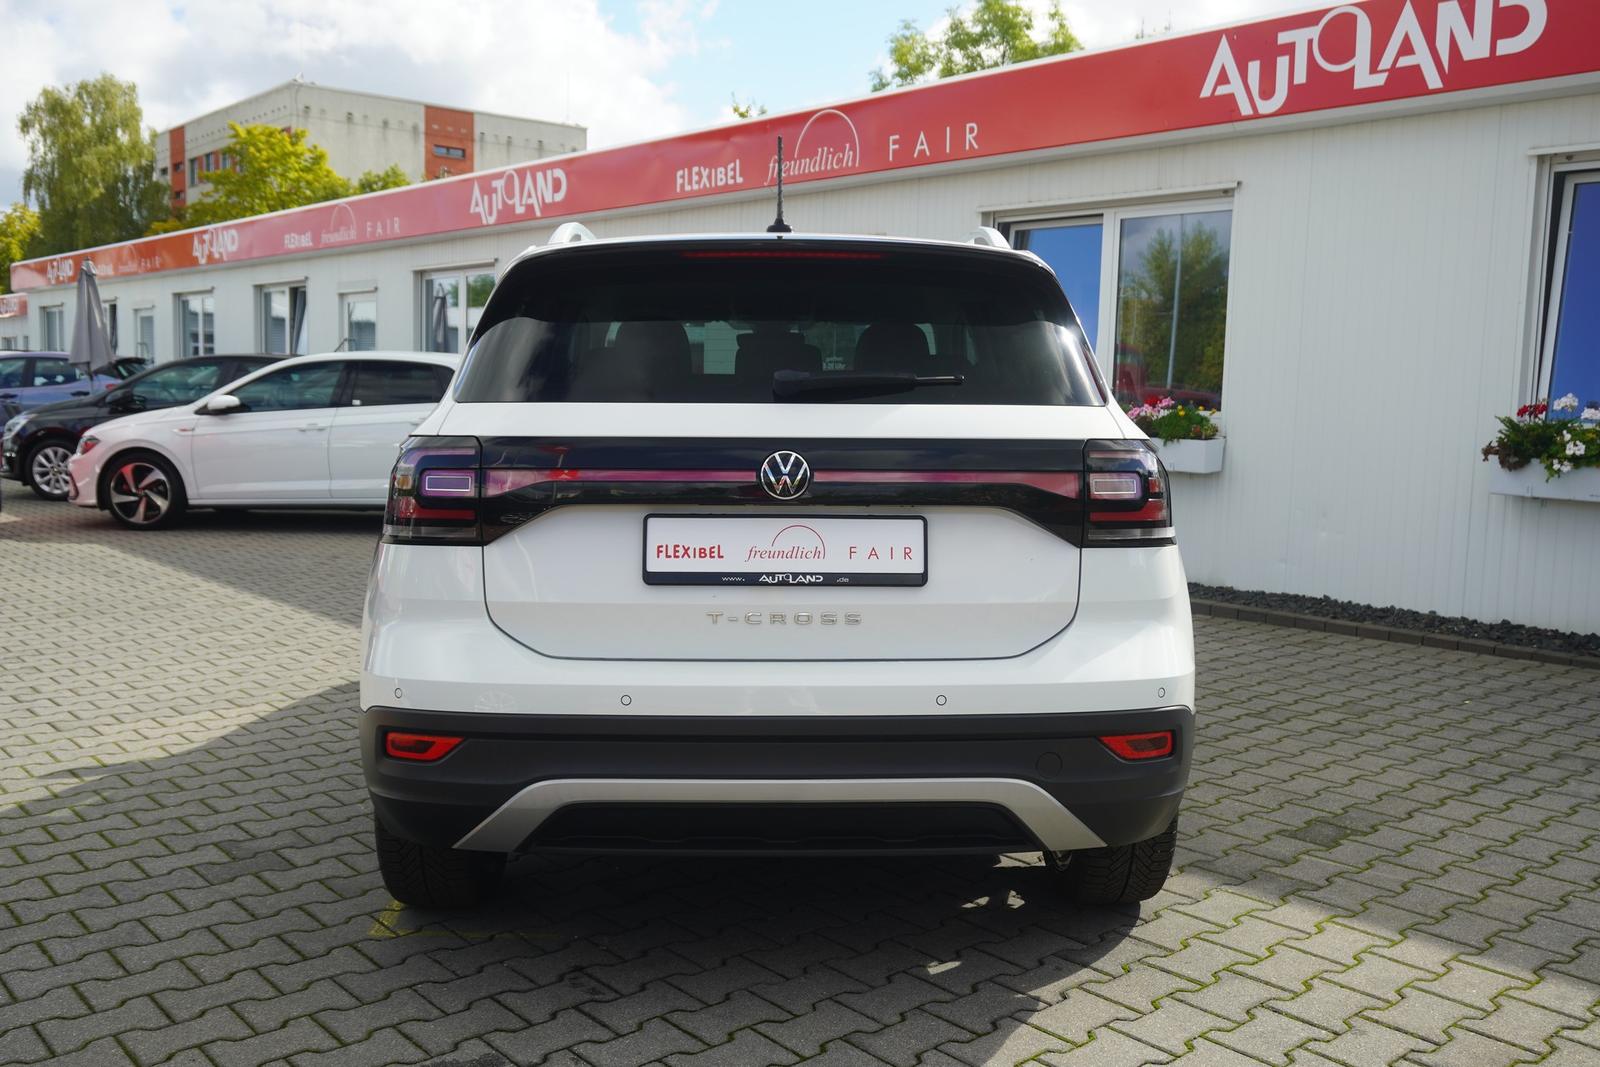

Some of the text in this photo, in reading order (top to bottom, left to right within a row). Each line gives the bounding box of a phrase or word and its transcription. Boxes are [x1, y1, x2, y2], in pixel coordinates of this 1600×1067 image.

[1199, 0, 1549, 116] AUTOLAND
[676, 159, 744, 193] FLEXIBEL
[888, 121, 979, 162] FAIR
[469, 168, 567, 225] AUTOLAND
[656, 544, 912, 563] FLEXIBEL freundlich FAIR
[759, 573, 823, 584] AUTOLAND
[705, 611, 862, 626] T-CROSS
